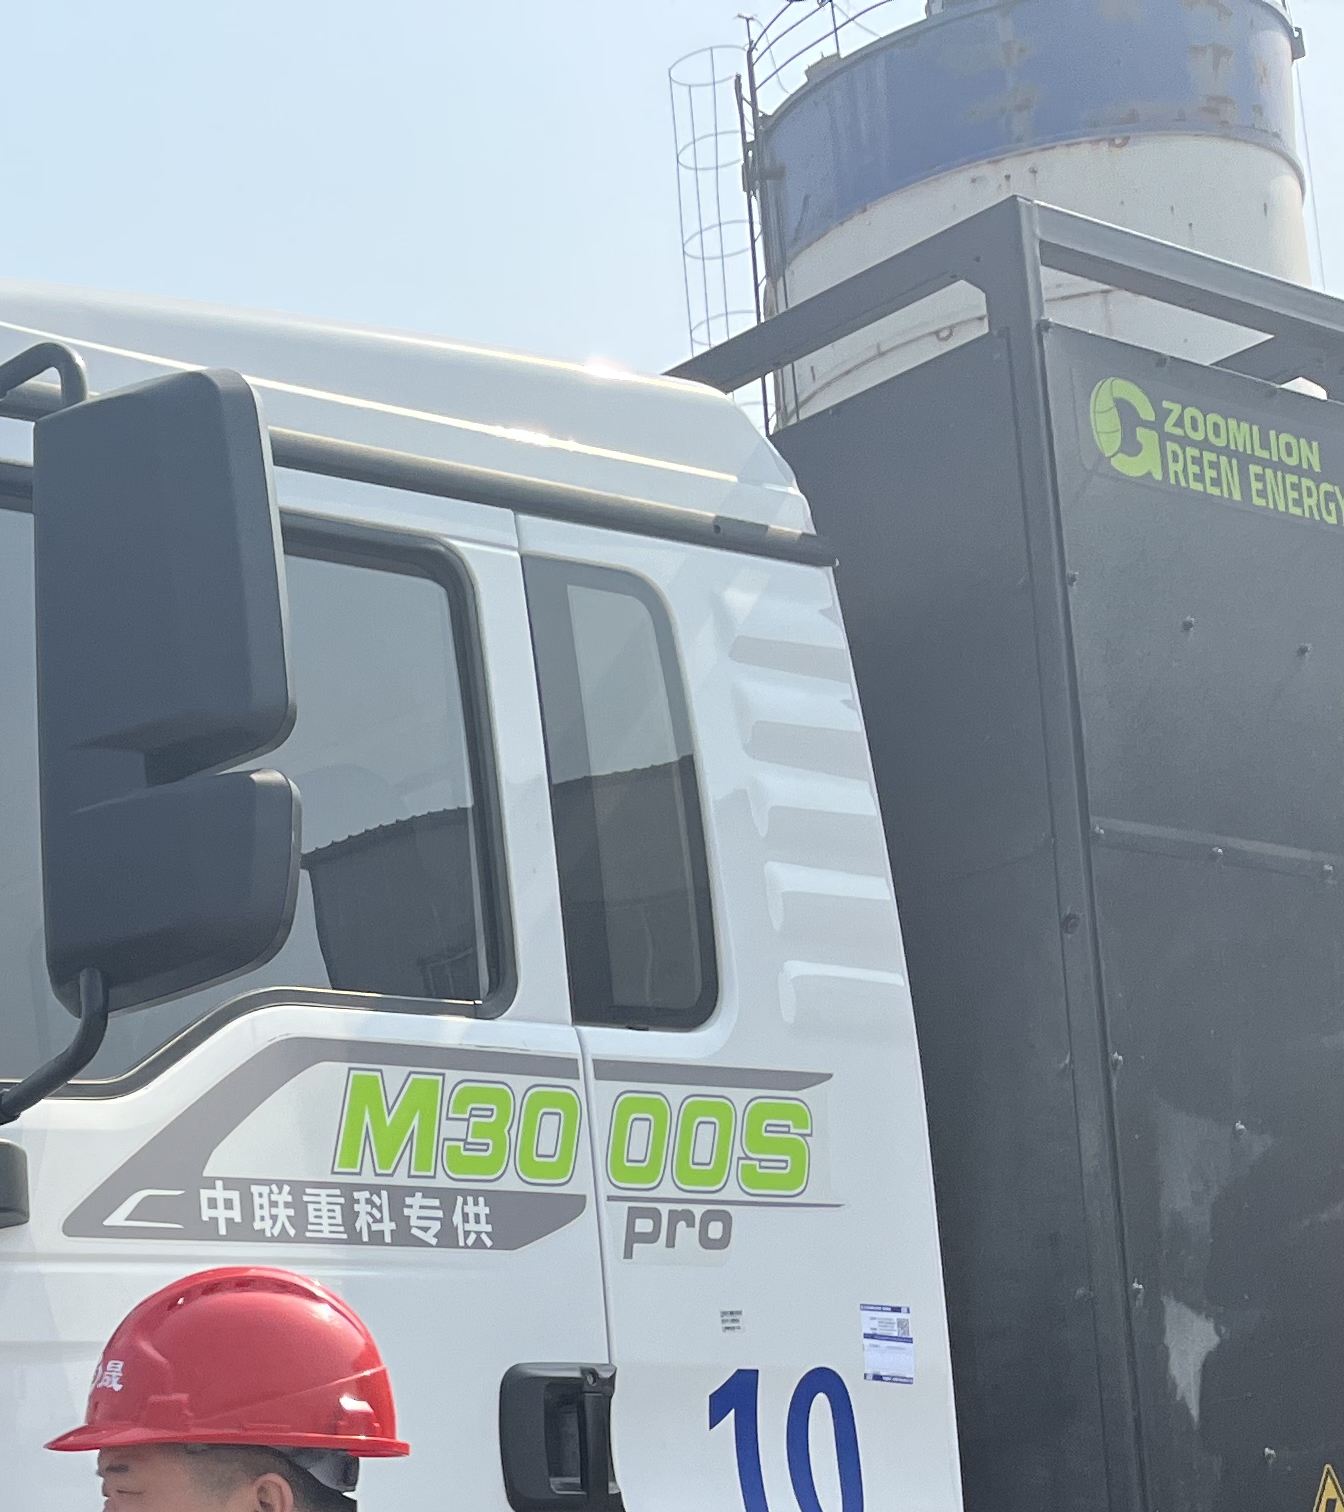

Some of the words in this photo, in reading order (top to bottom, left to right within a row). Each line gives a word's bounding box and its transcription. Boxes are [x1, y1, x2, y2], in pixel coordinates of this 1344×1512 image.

[1162, 399, 1322, 473] ZOOMLION
[198, 1179, 494, 1250] 中联重科专供
